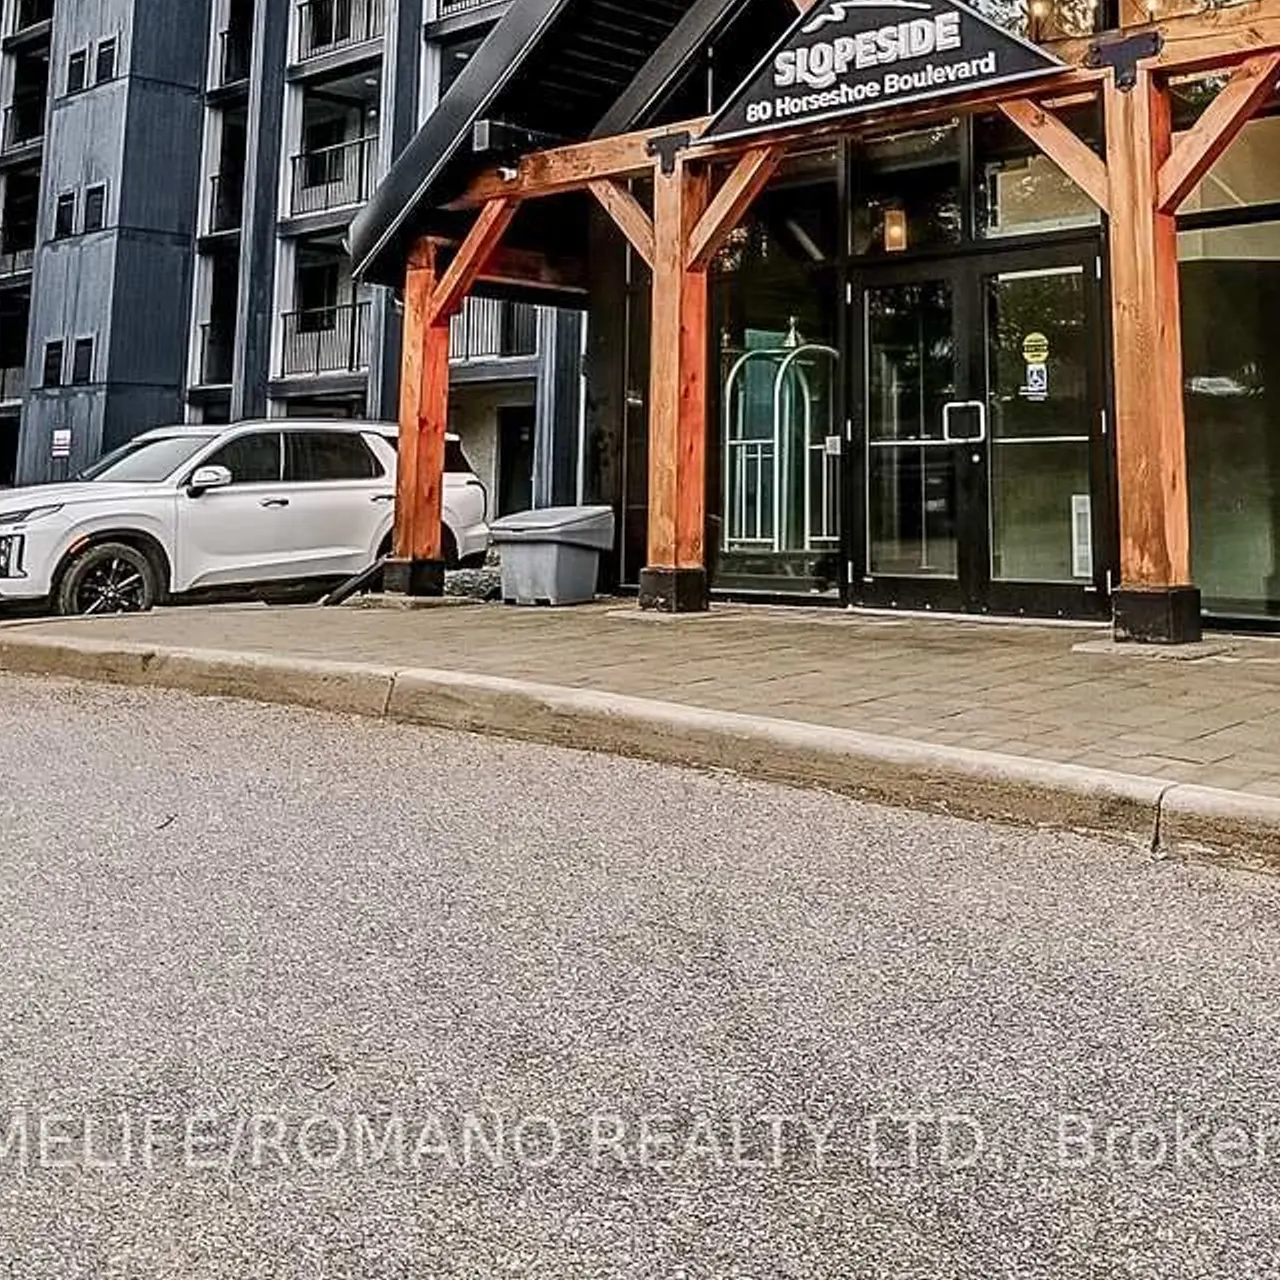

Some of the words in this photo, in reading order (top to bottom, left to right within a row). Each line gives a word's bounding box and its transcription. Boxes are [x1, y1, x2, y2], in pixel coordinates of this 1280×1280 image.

[773, 10, 963, 89] SLOPESIDE
[746, 103, 771, 122] 80
[775, 79, 880, 118] Horseshoe
[884, 52, 996, 95] Boulevard
